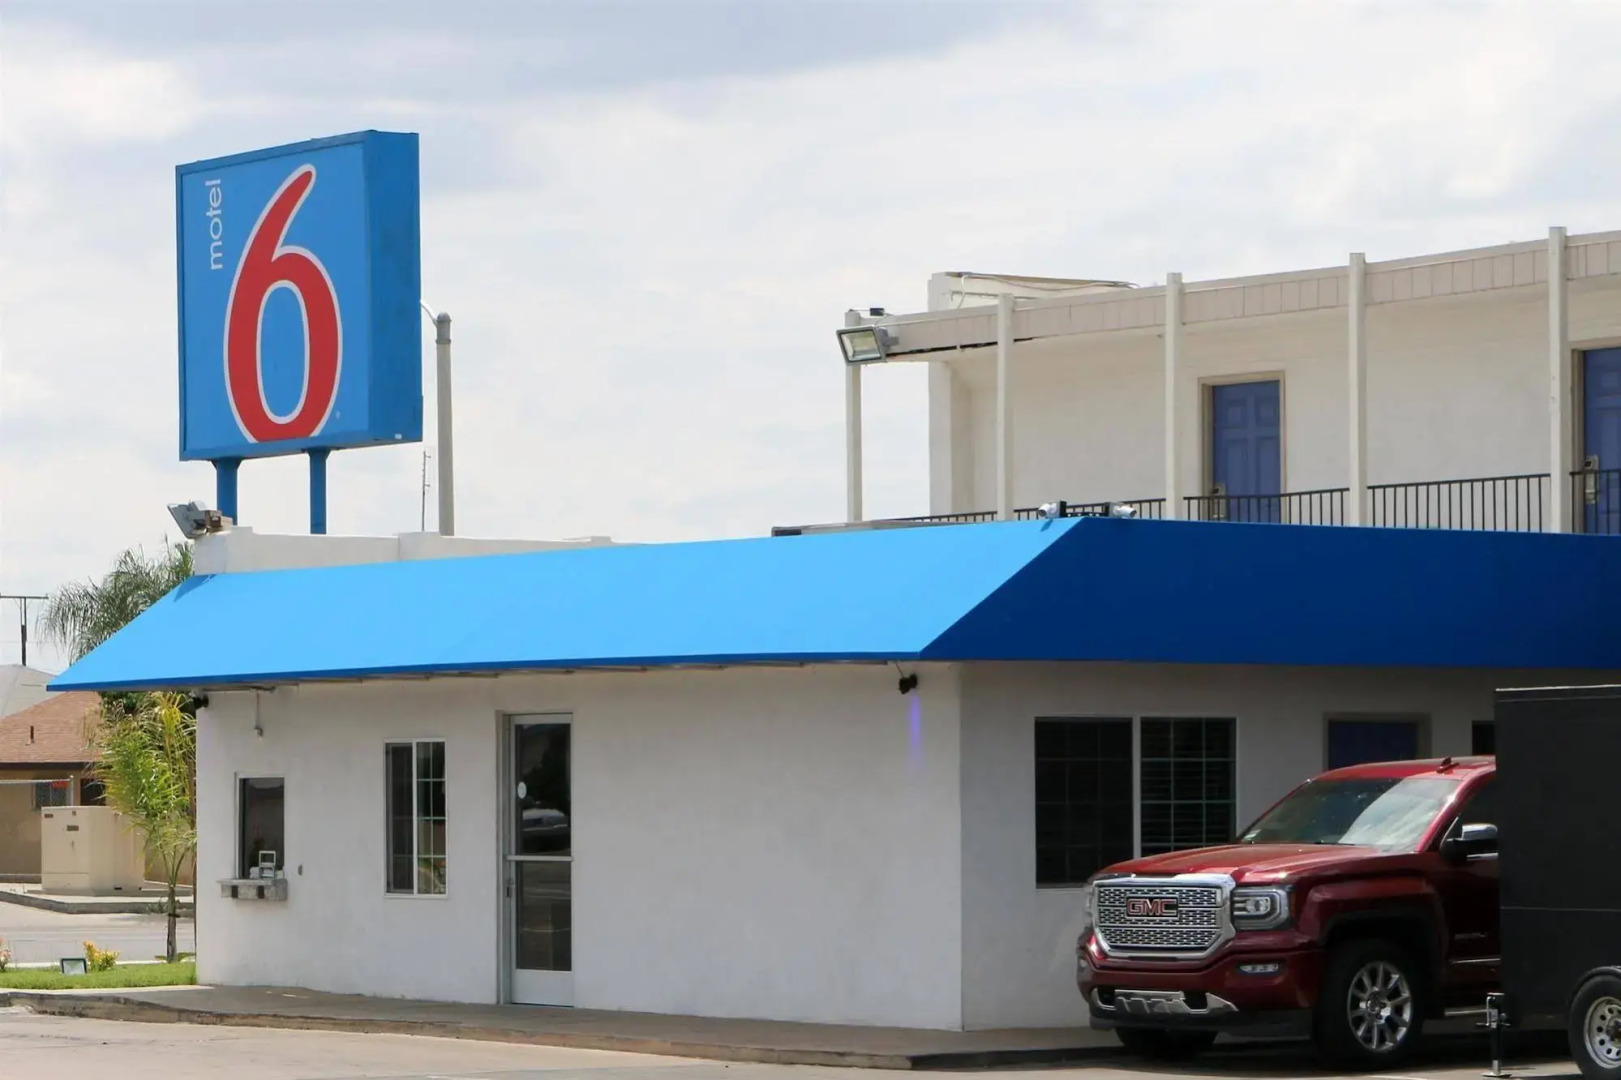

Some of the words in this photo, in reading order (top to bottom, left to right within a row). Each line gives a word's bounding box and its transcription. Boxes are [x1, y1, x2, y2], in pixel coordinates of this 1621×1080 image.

[205, 179, 223, 270] motel
[223, 163, 343, 443] 6
[1127, 898, 1177, 916] GMC
